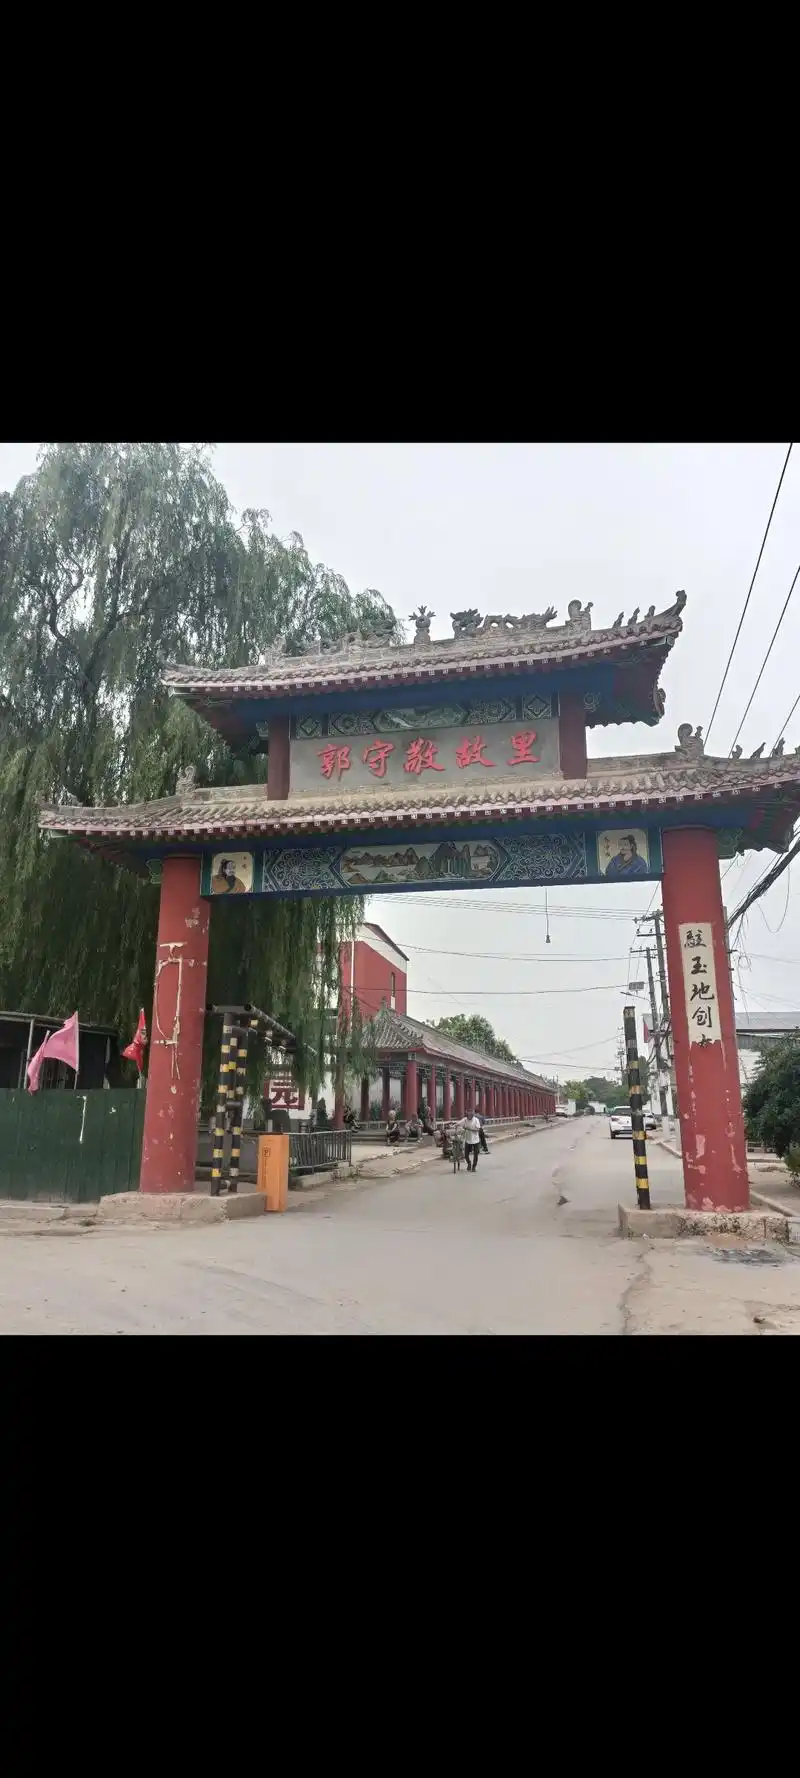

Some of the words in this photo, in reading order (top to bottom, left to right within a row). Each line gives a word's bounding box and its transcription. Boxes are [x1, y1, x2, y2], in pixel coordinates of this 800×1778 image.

[317, 728, 542, 781] 郭守敬故里
